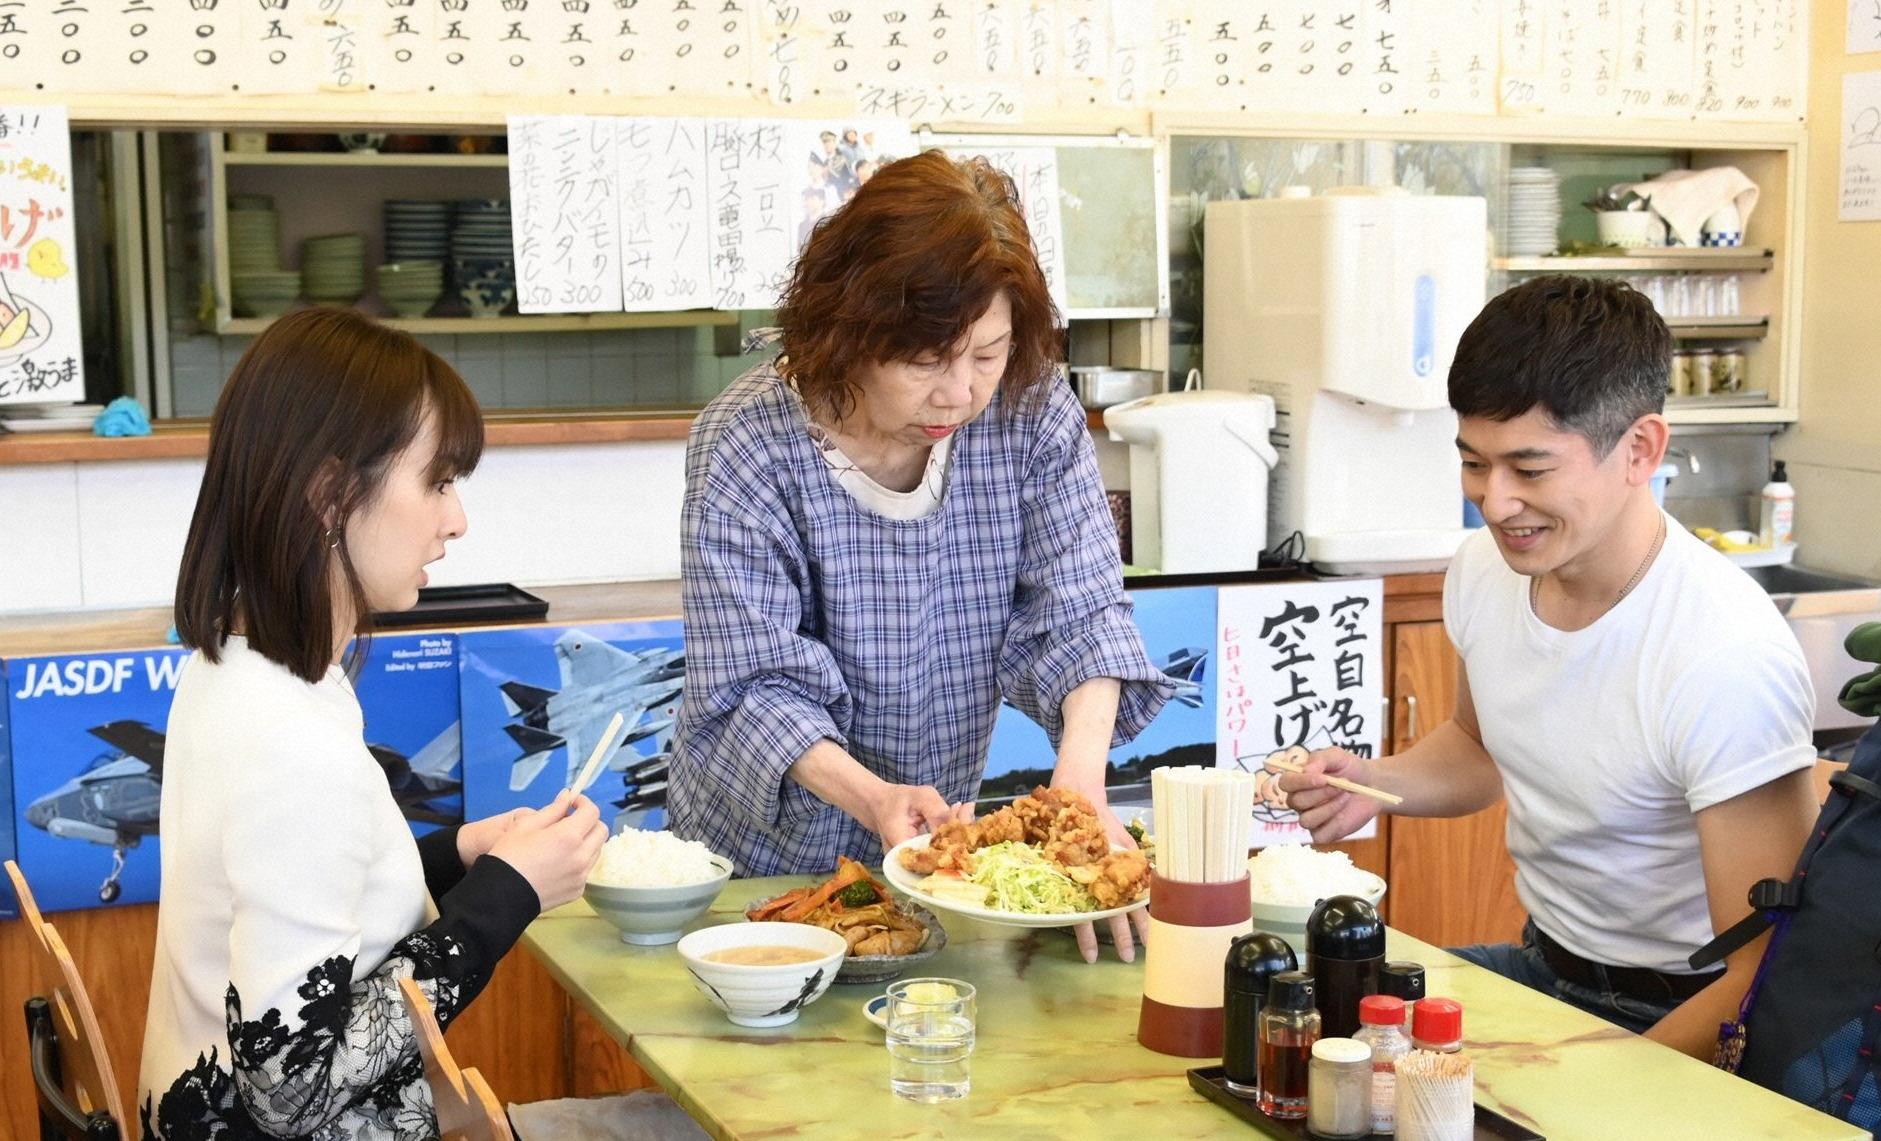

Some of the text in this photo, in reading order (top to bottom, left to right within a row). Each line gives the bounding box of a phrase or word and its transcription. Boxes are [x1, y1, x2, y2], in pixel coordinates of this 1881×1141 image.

[0, 1, 28, 59] 五〇
[981, 92, 1014, 118] 700
[663, 119, 698, 297] ハムカツ 300
[560, 279, 602, 304] 300
[15, 658, 135, 699] JASDF
[1258, 600, 1328, 748] 空上げ
